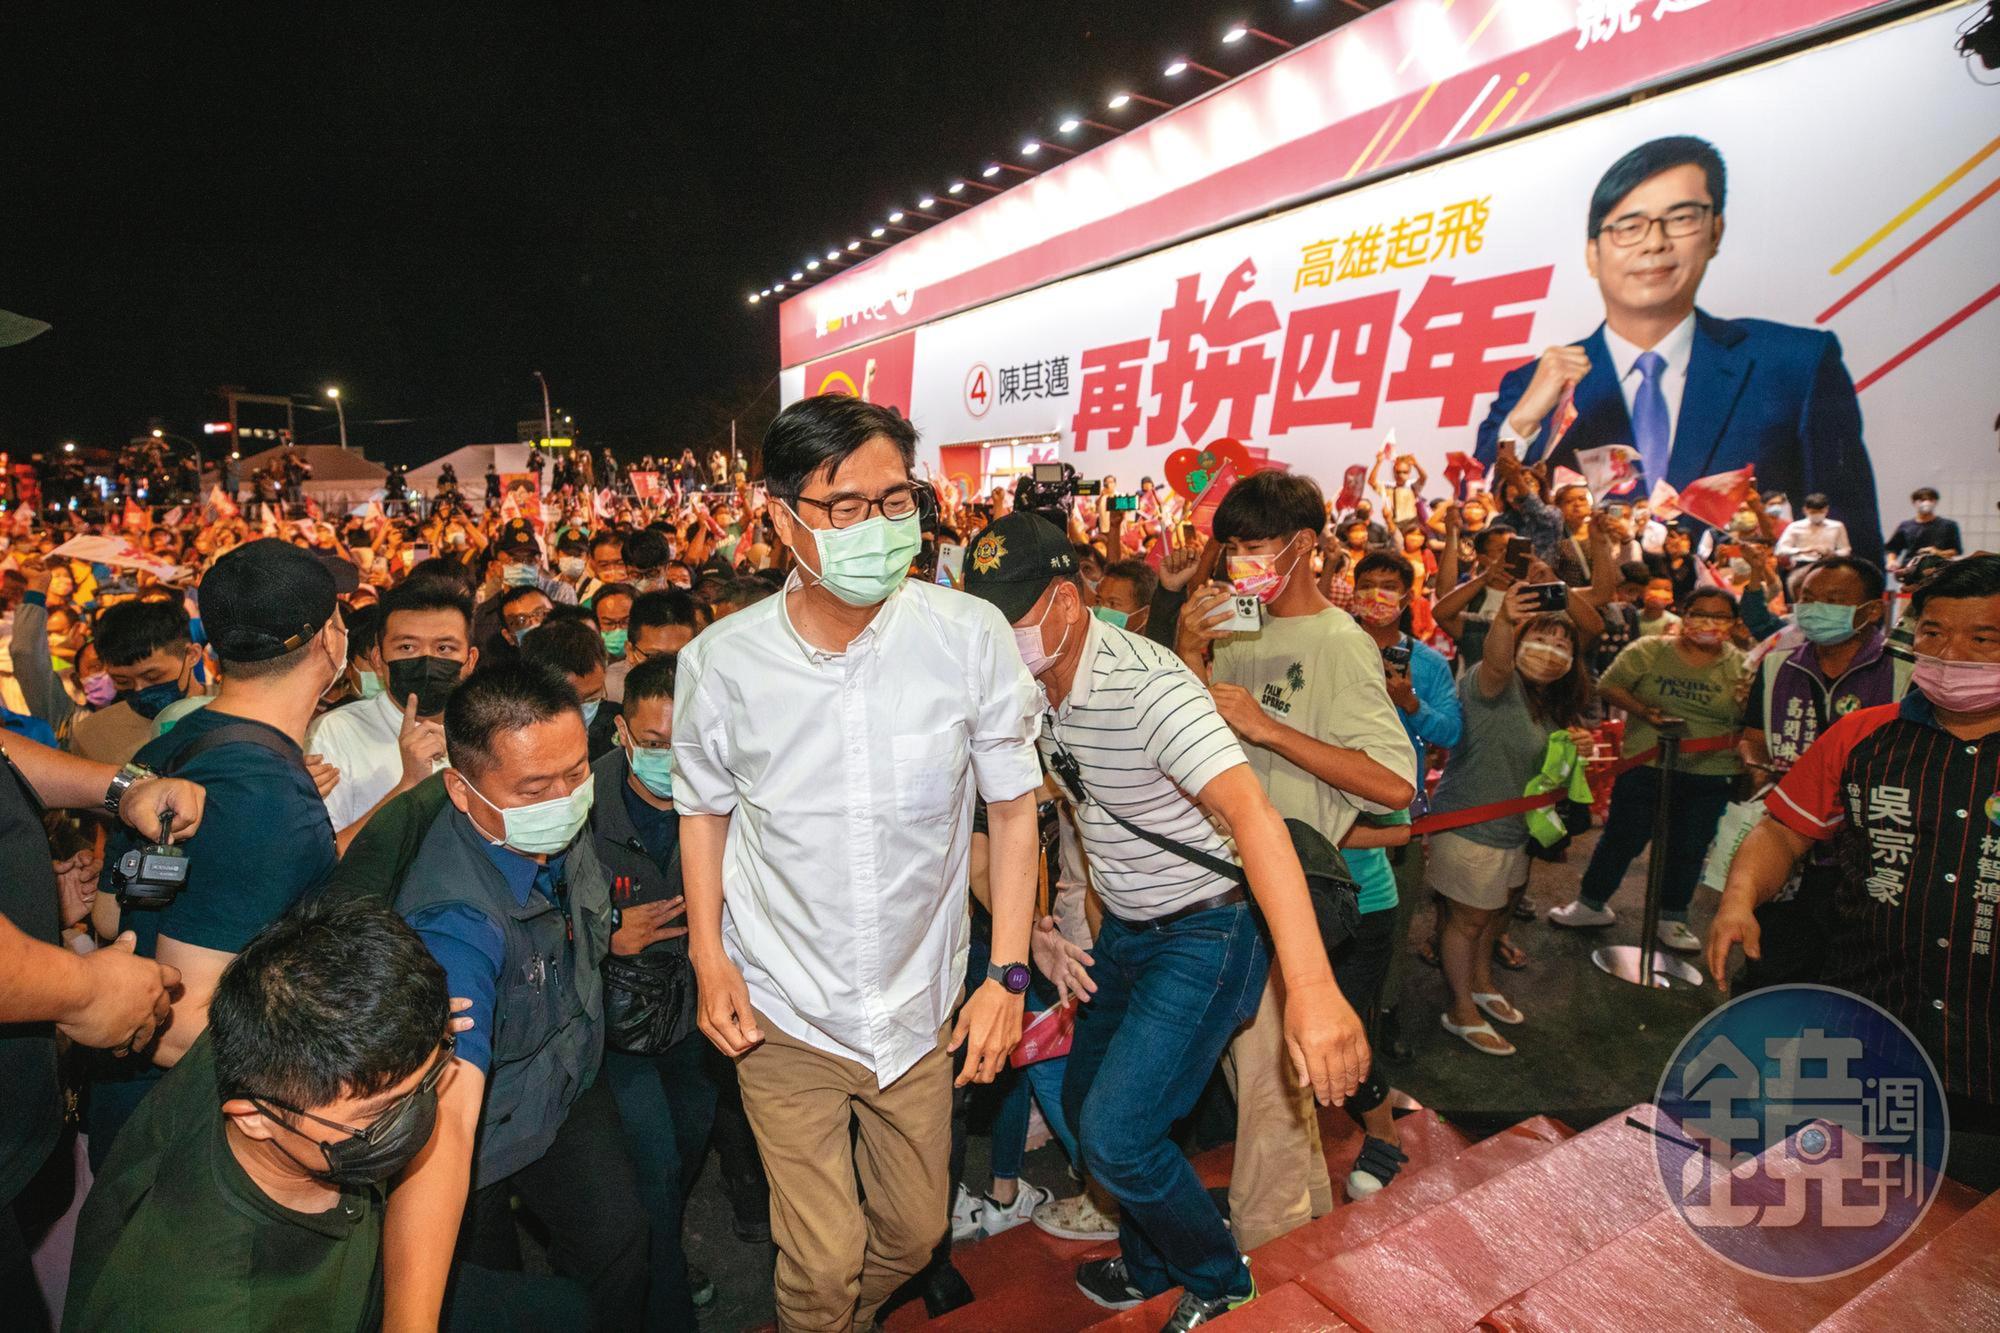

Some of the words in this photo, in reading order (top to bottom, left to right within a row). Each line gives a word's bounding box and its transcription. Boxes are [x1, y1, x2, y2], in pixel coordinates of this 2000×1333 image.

[1294, 195, 1492, 293] 高雄起飛
[998, 356, 1070, 405] 陳其邁
[1264, 683, 1283, 696] PALM
[1865, 785, 1916, 907] 吳宗豪
